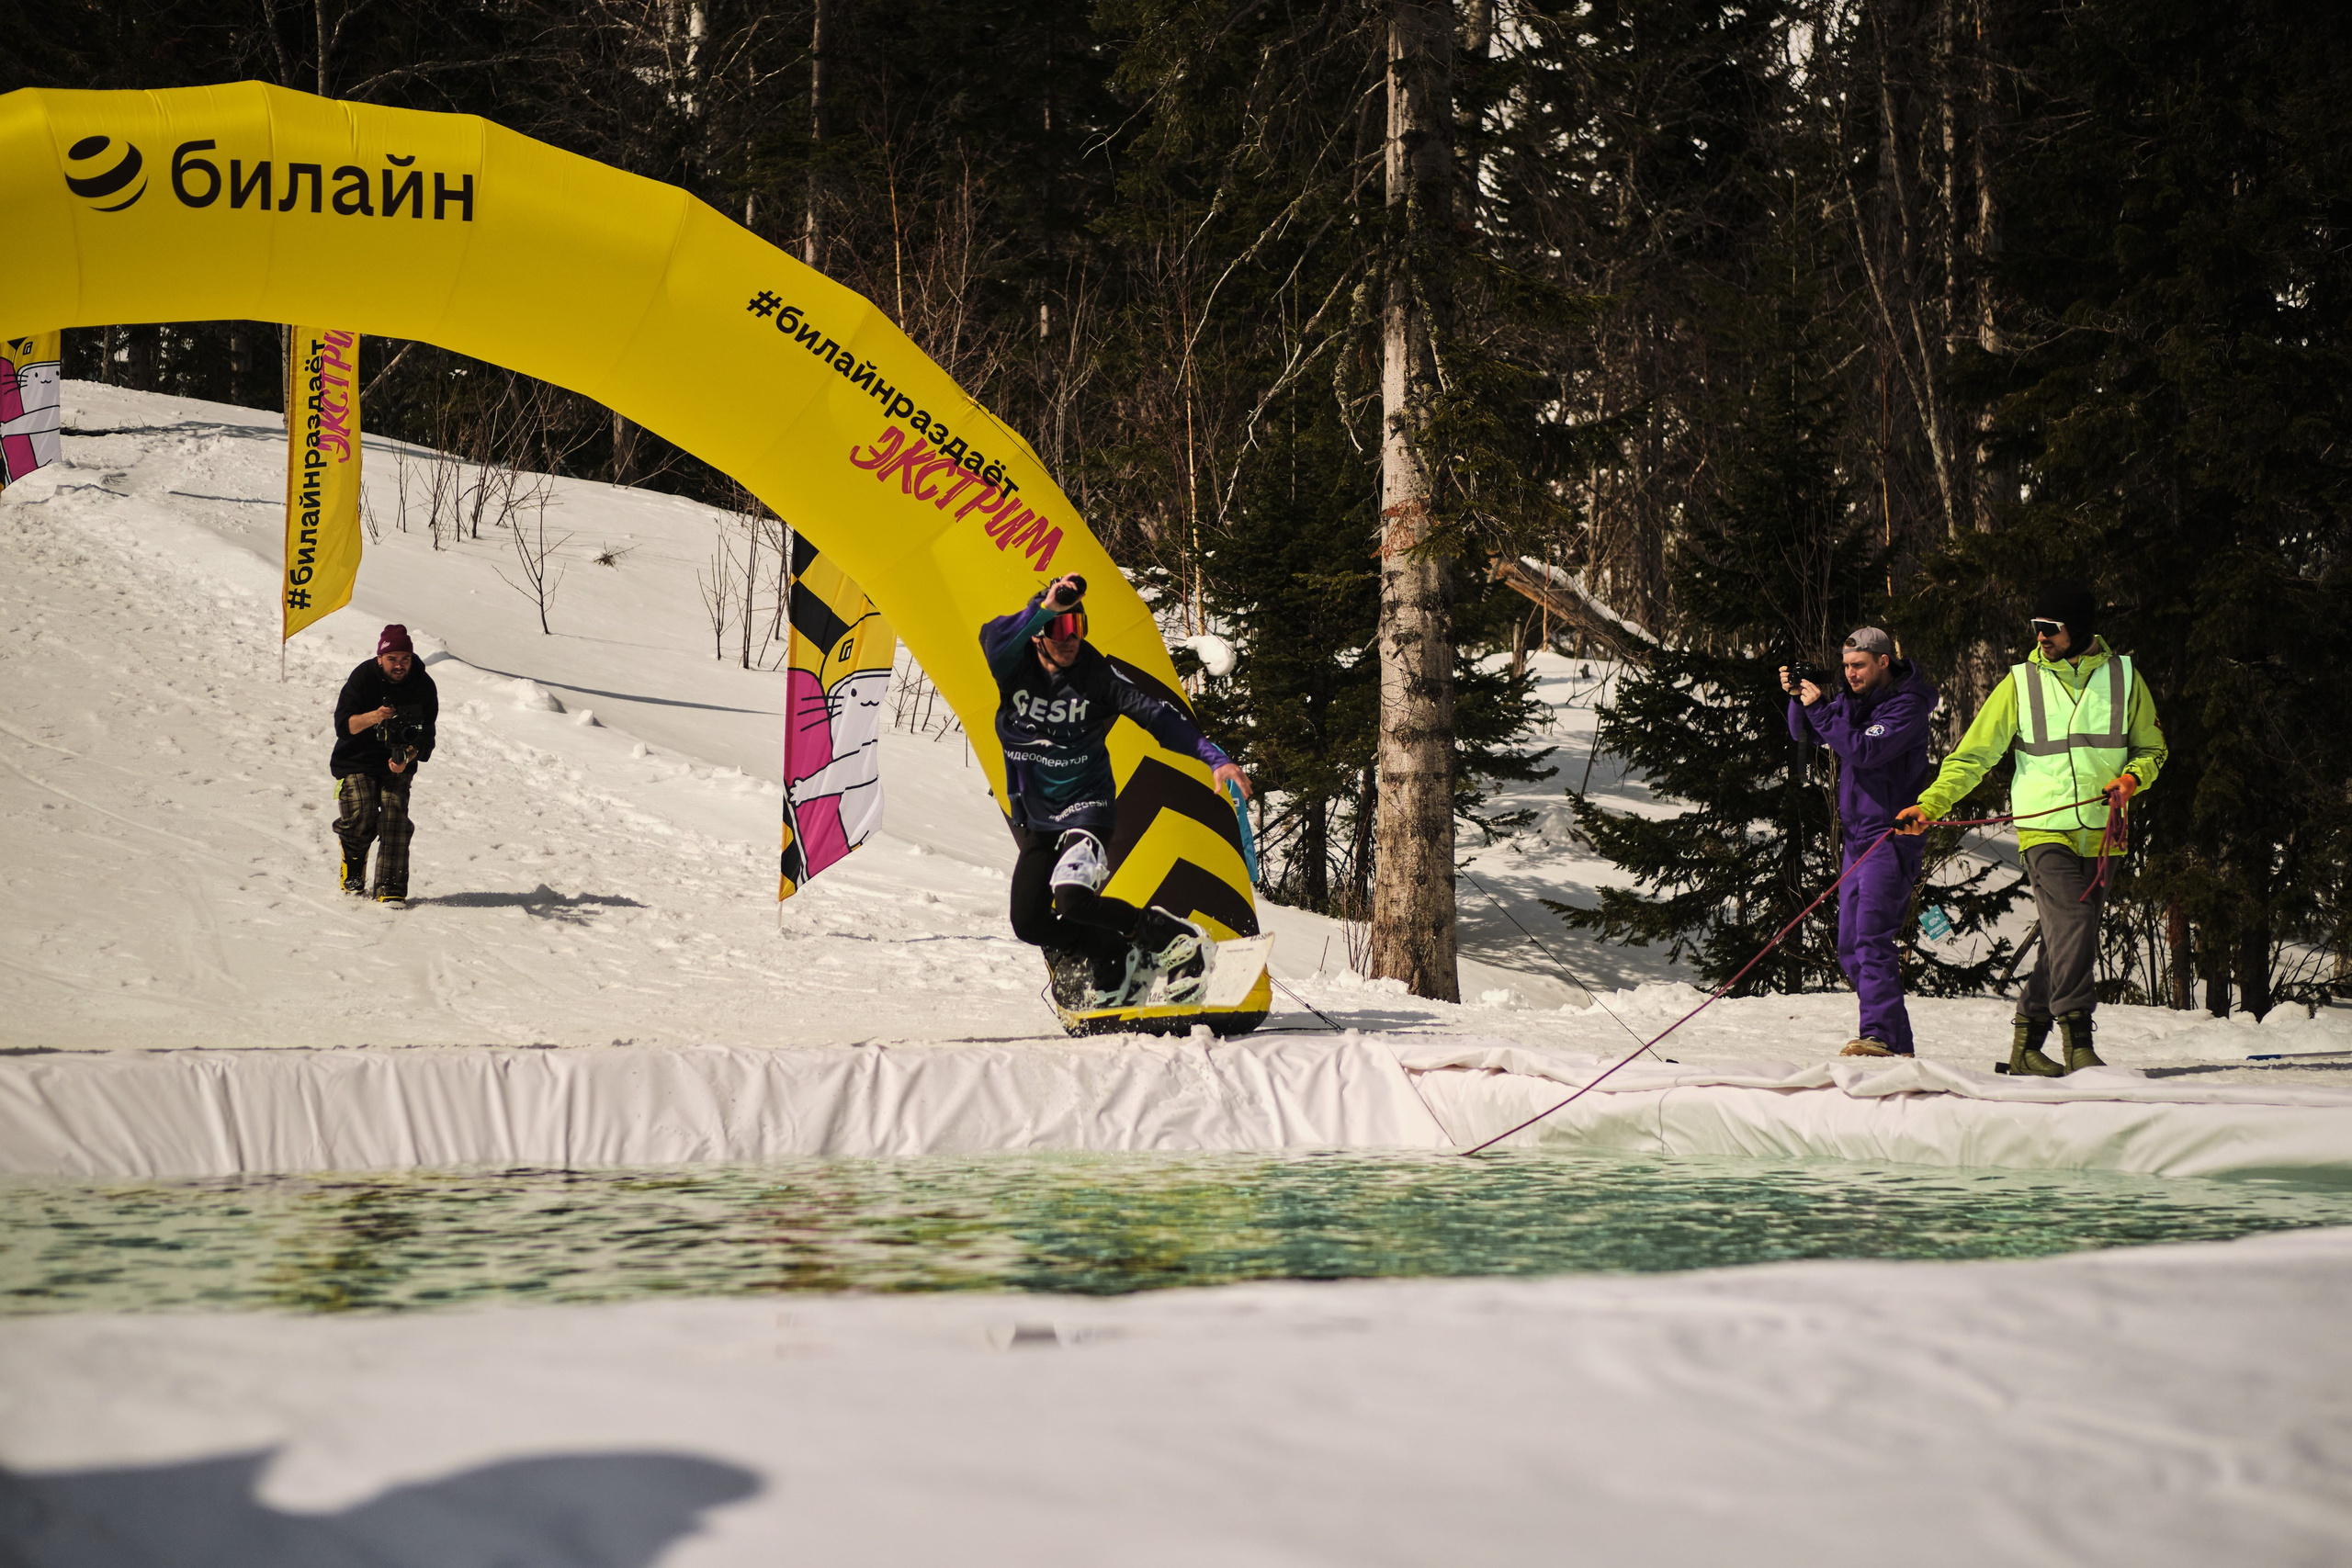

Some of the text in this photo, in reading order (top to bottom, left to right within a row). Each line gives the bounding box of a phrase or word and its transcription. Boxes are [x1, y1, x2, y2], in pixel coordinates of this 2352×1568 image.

[171, 139, 474, 222] билайн
[316, 329, 356, 464] ЭКСТРИ
[746, 290, 1019, 500] #билайнраздаёт
[287, 339, 327, 610] #билайнраздаёт
[849, 424, 1064, 571] ЭКСТРИМ
[1012, 689, 1091, 724] GESH
